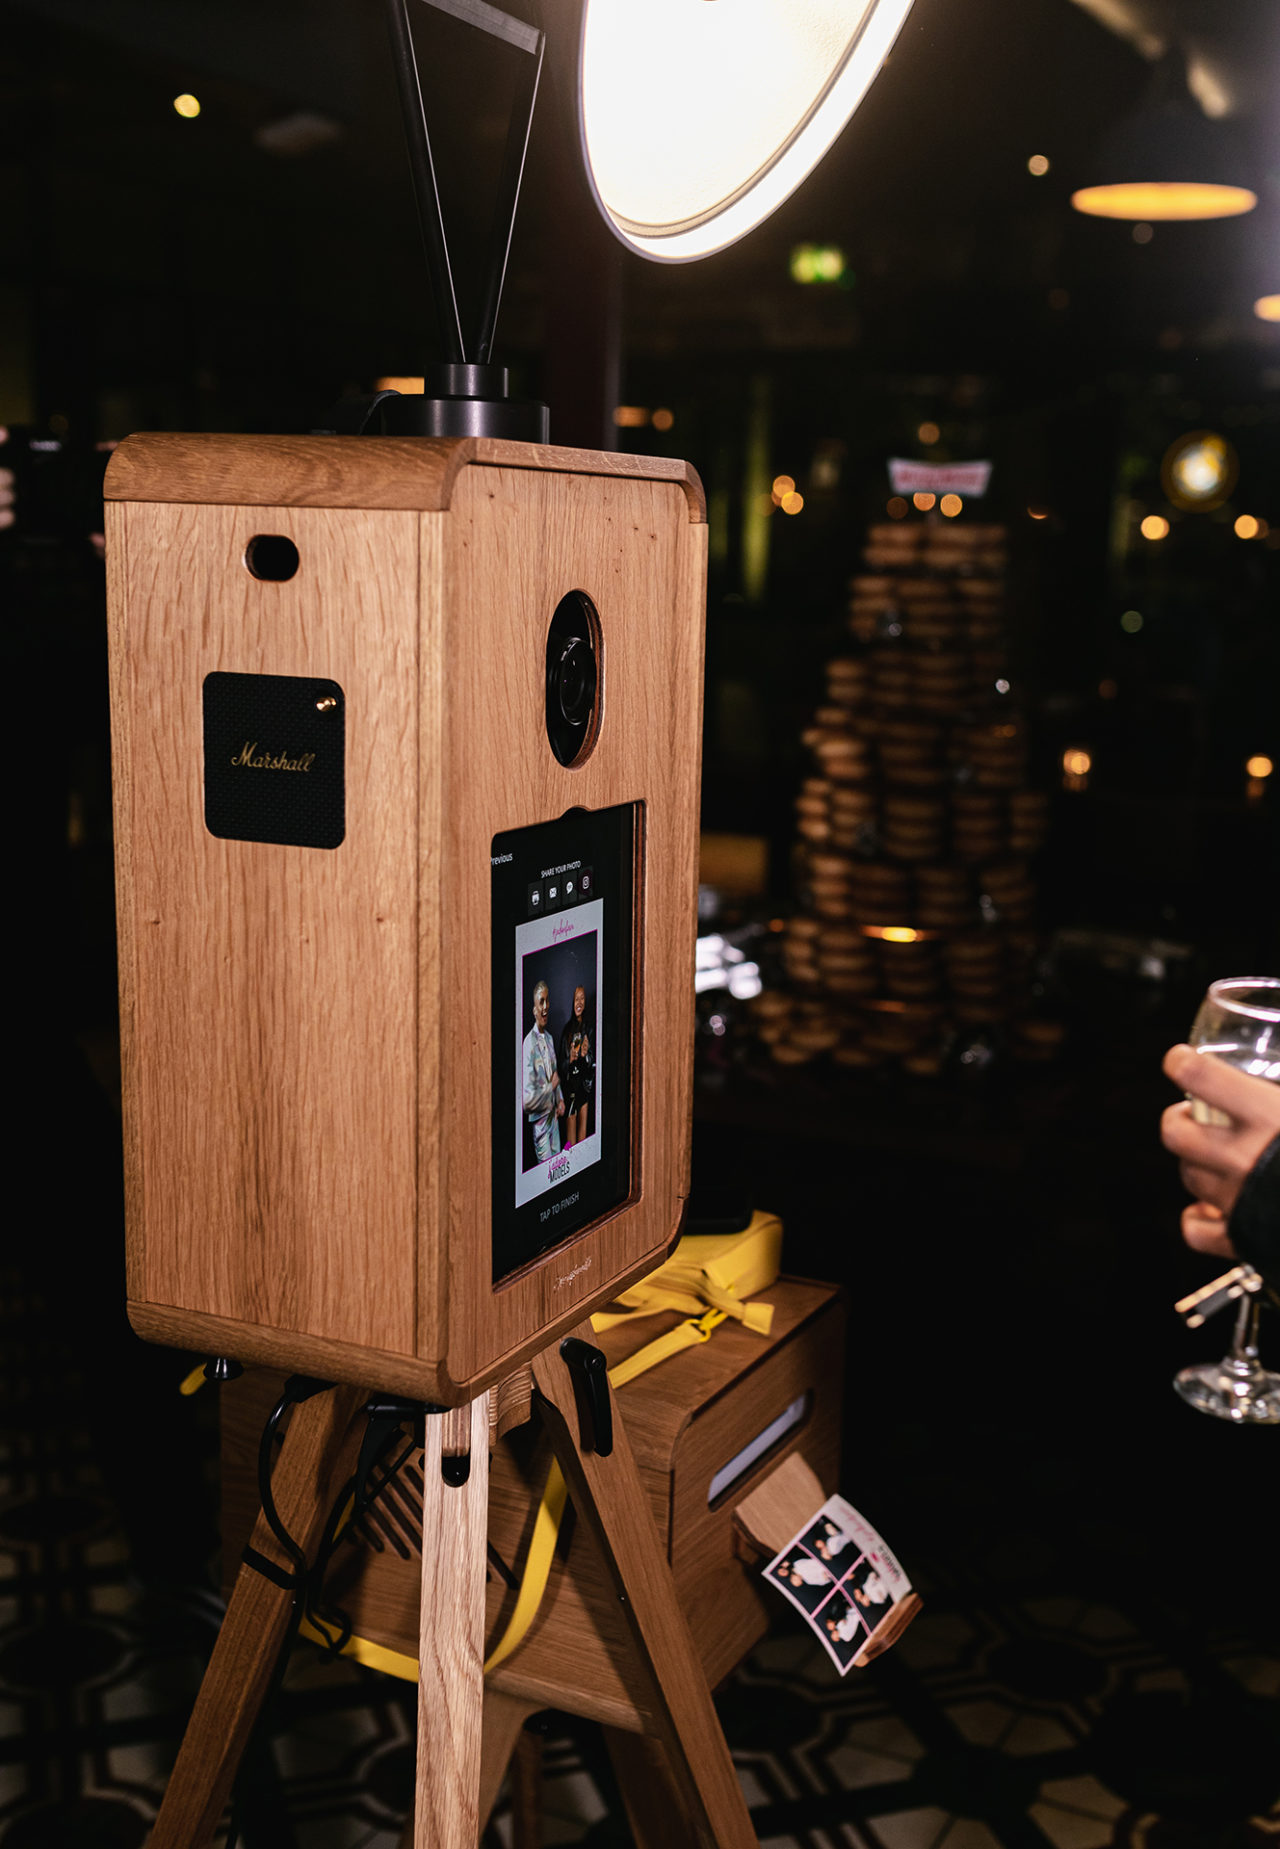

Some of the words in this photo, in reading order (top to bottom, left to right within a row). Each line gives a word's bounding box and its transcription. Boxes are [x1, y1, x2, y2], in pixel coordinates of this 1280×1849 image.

[231, 741, 316, 772] Marshall
[491, 853, 513, 866] revious
[541, 867, 555, 879] SHARE
[555, 864, 567, 875] YOUR
[567, 860, 582, 871] PHOTO
[540, 1208, 551, 1222] TAP
[552, 1203, 560, 1215] TO
[561, 1192, 580, 1209] FINISH
